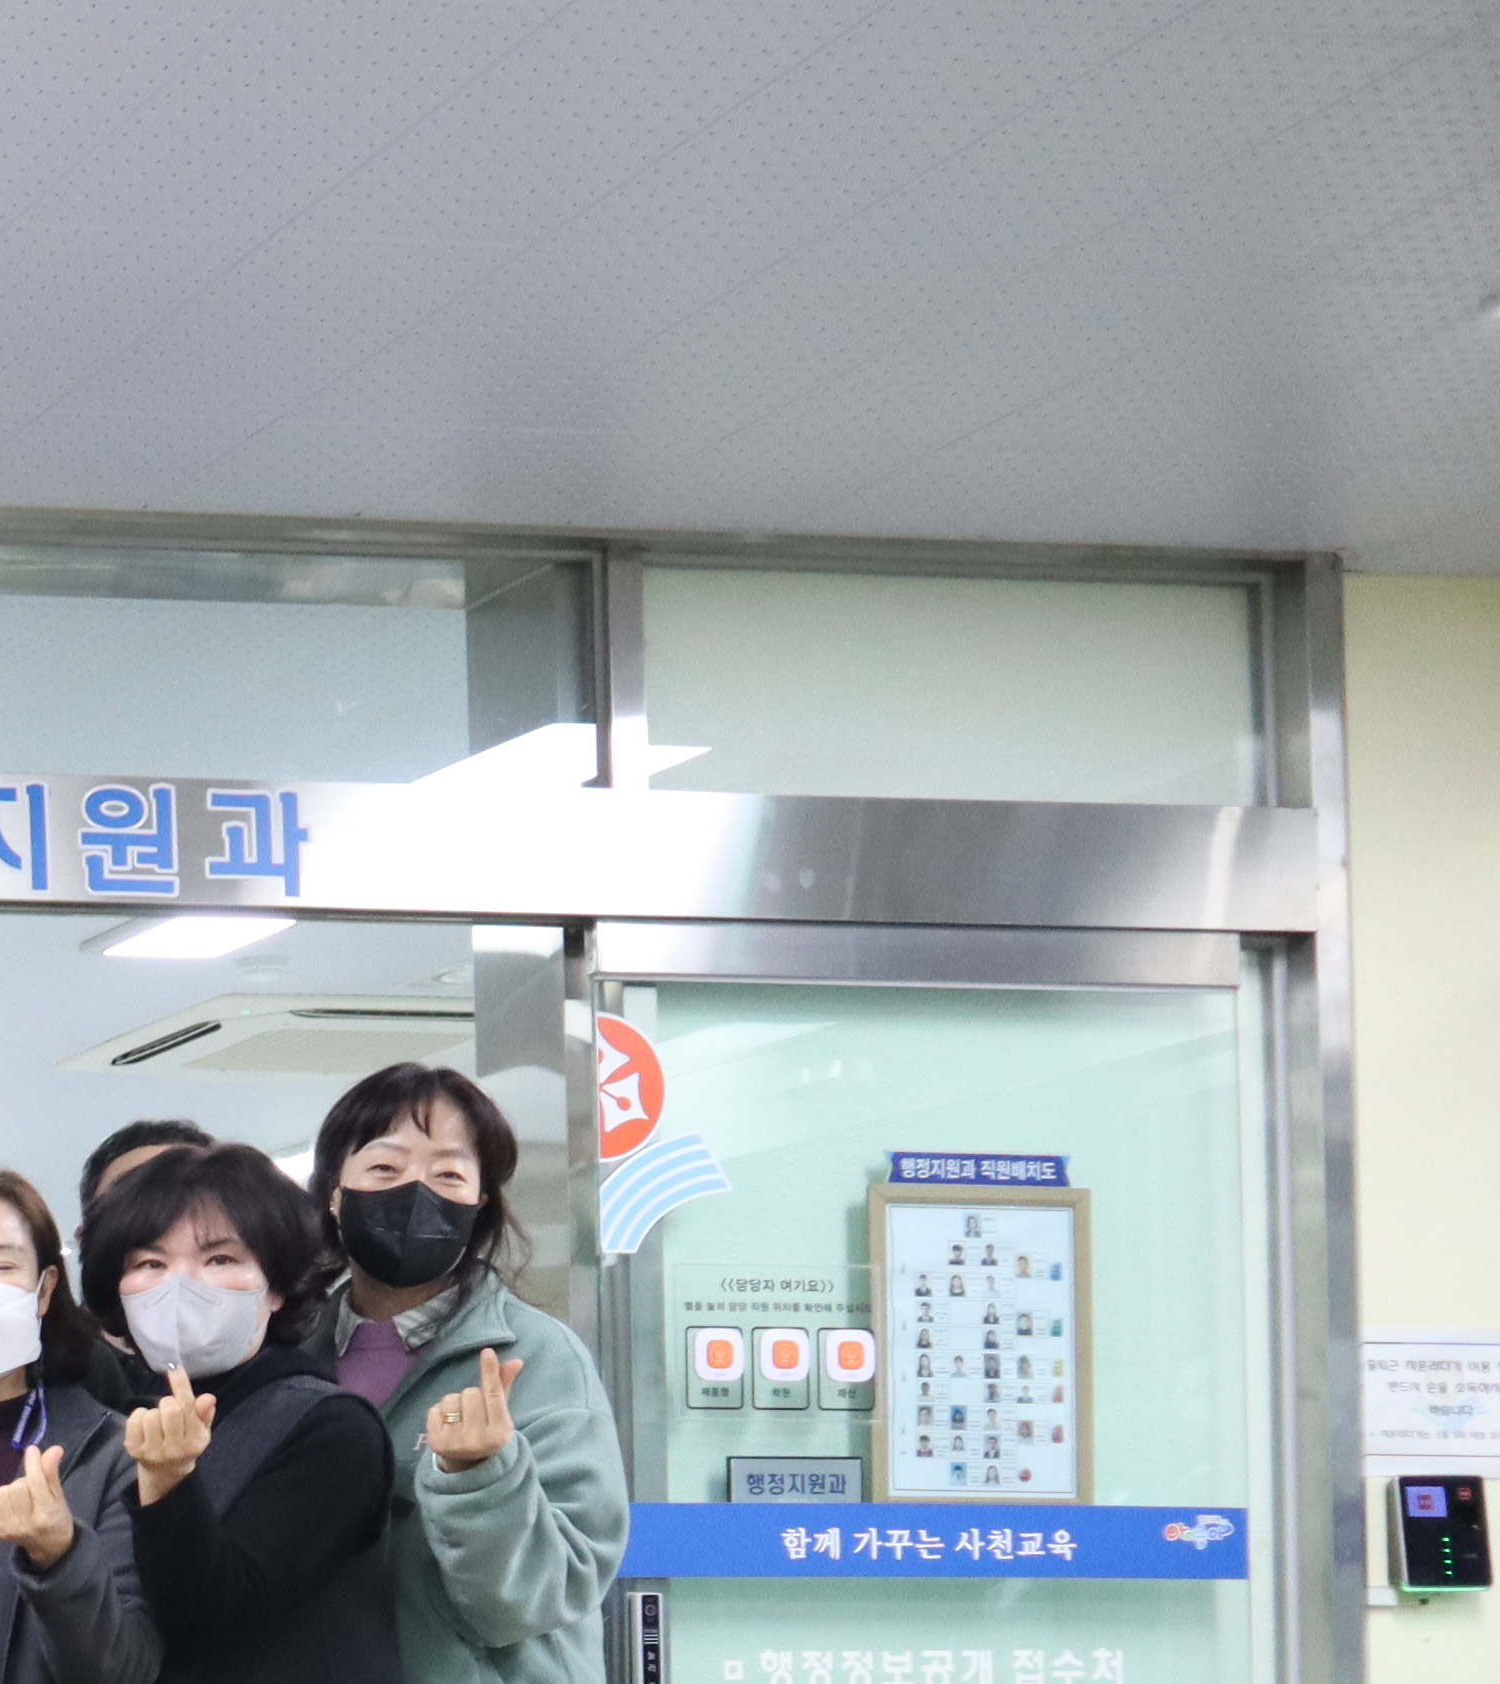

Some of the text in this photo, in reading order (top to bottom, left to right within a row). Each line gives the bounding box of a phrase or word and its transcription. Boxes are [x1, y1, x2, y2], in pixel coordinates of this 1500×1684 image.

[900, 1157, 1057, 1181] 행정지원과 직원배치도
[746, 1473, 847, 1497] 행정지원과
[781, 1527, 1078, 1561] 함께 가꾸는 사천교육
